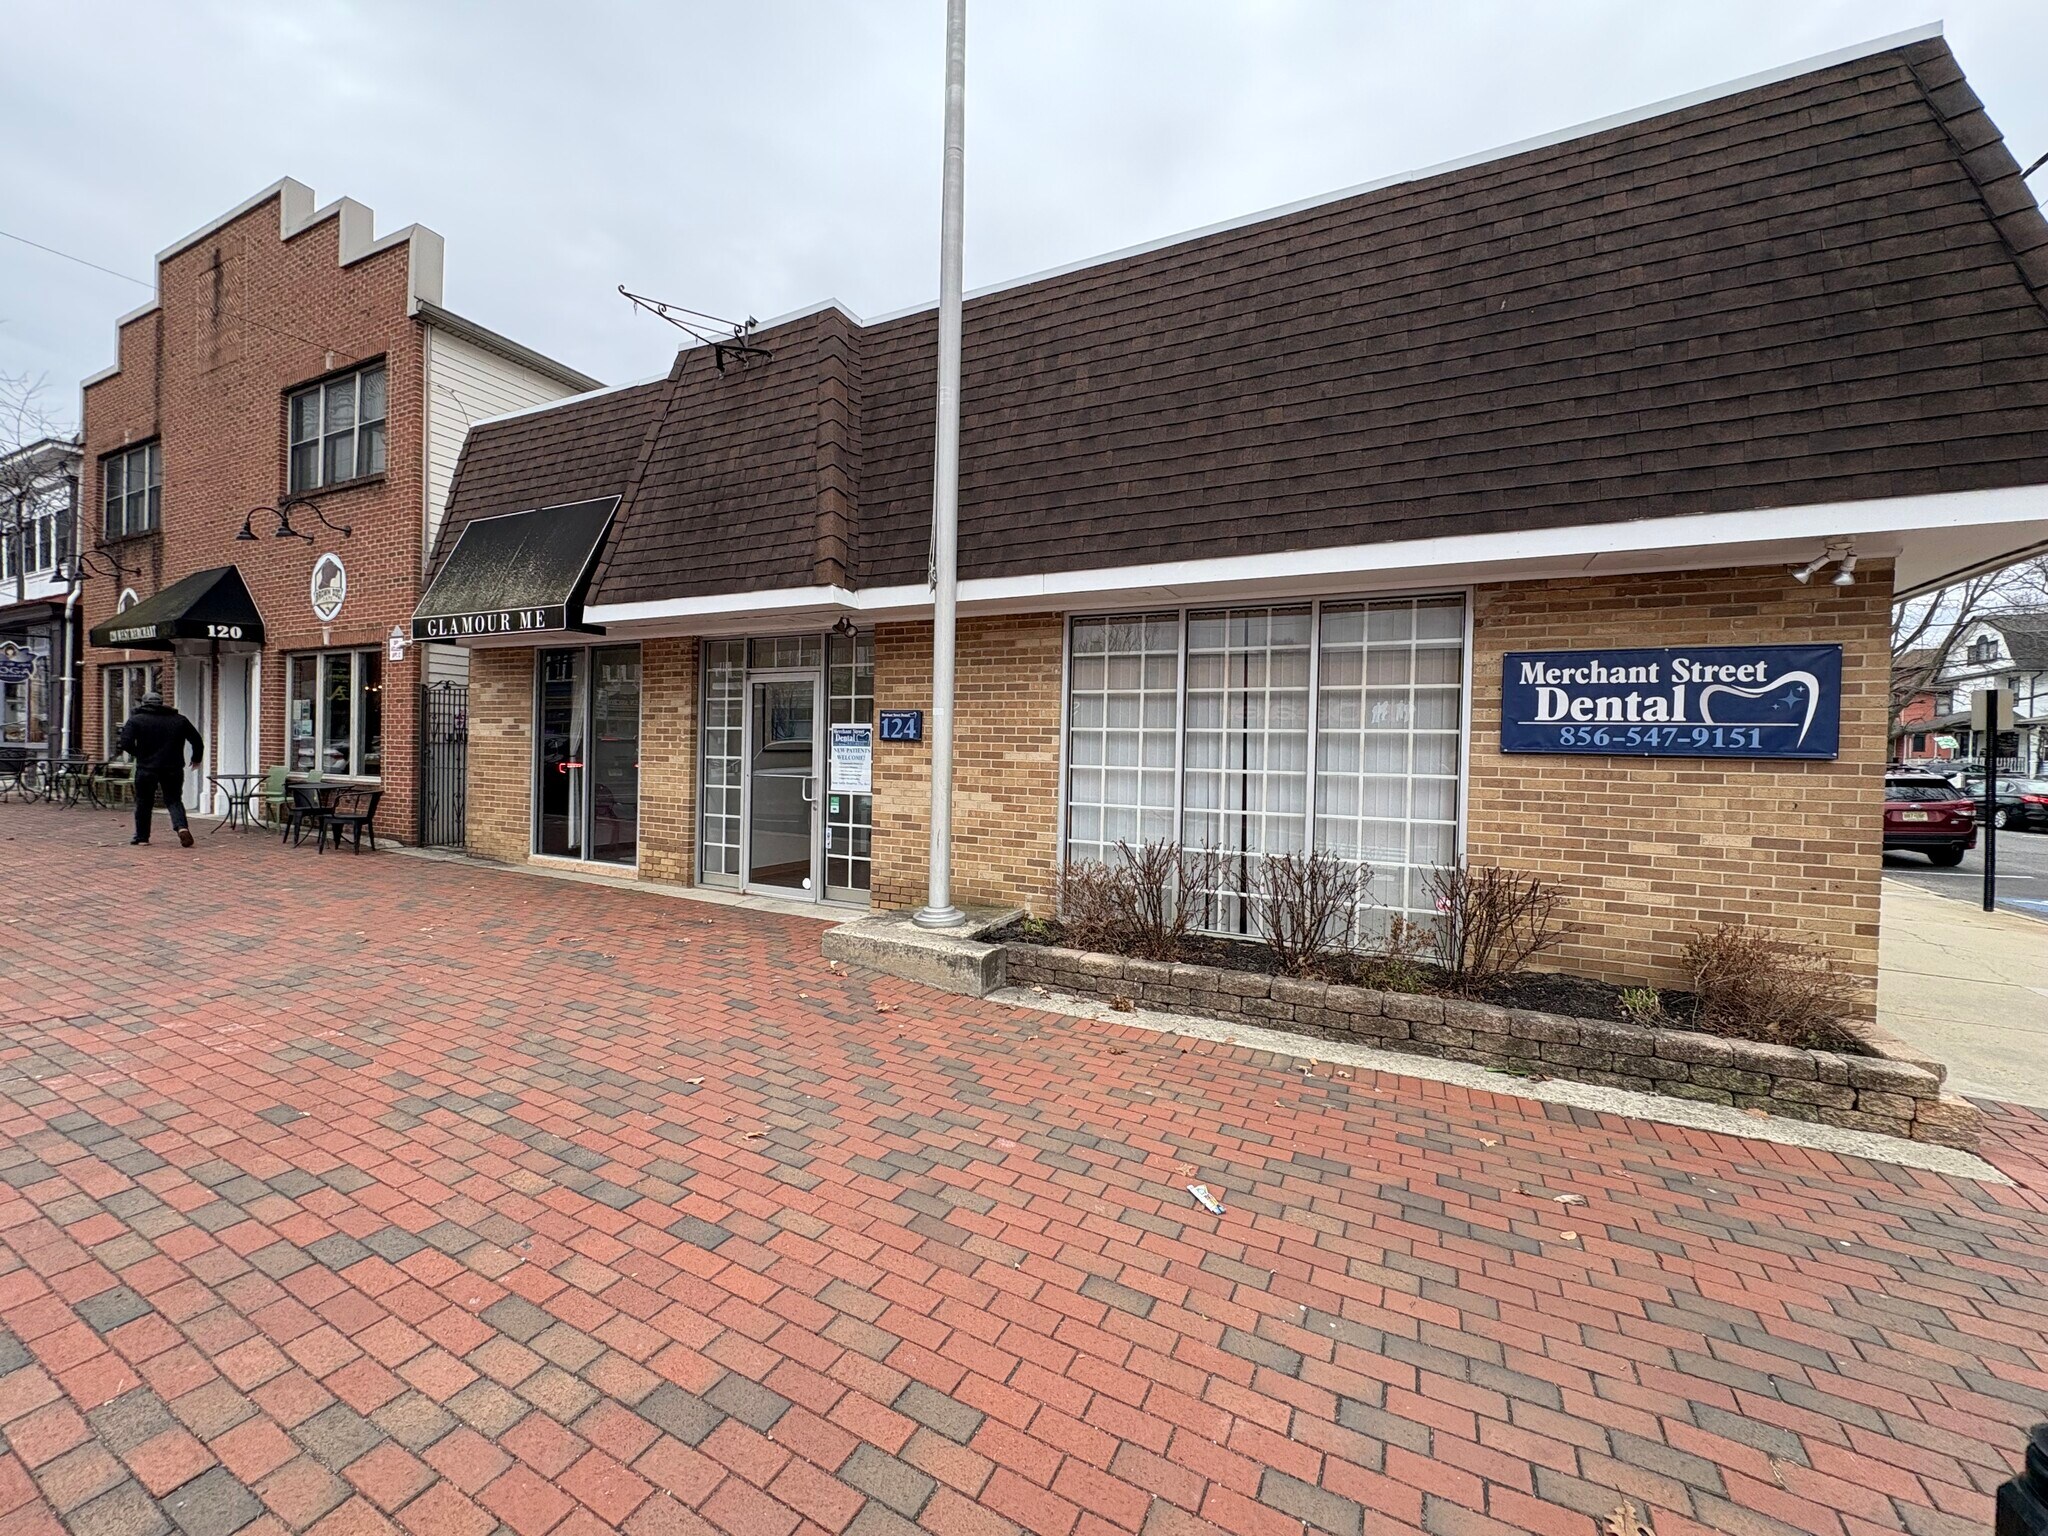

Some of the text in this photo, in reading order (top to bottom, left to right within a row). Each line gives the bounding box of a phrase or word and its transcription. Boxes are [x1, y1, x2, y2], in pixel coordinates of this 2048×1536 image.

[207, 624, 243, 639] 120
[427, 609, 546, 636] GLAMOUR ME
[1519, 657, 1769, 685] Merchant Street
[1534, 684, 1687, 722] Dental
[835, 733, 856, 742] Dental
[881, 717, 917, 738] 124
[1559, 726, 1763, 749] 856-547-9151
